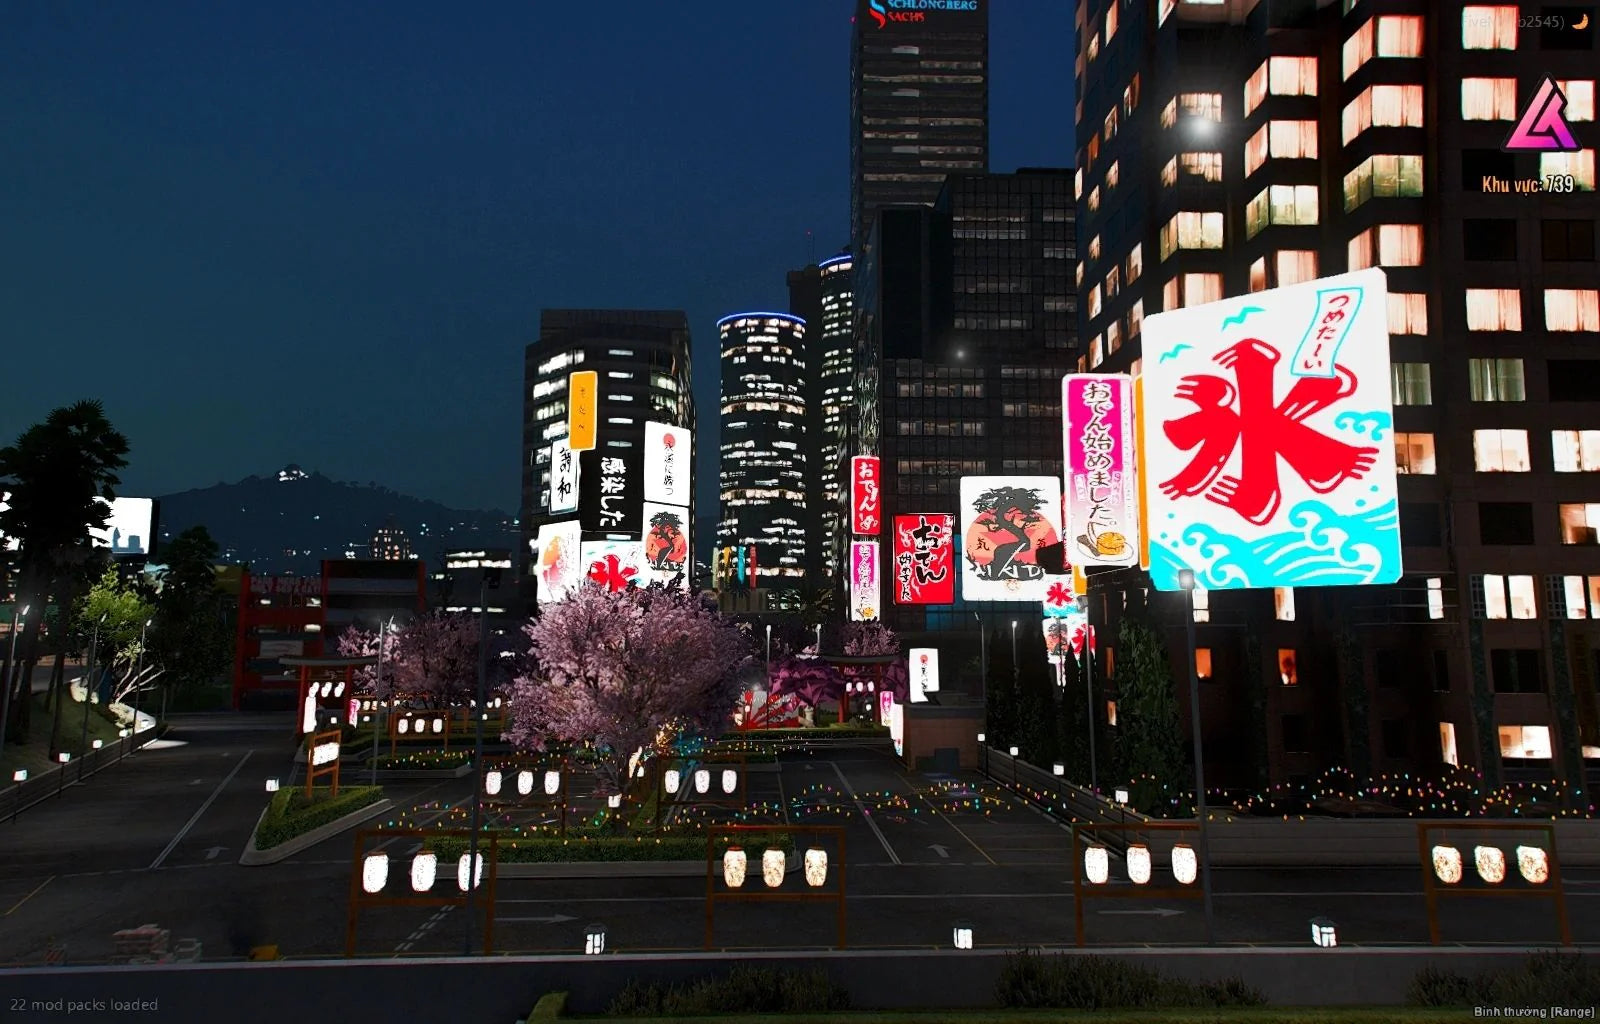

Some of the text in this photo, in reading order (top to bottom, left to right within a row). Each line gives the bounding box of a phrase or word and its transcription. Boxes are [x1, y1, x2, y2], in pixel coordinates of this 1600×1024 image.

[888, 0, 977, 10] SCHLONGBERG
[888, 11, 924, 22] SACHS
[1157, 338, 1380, 526] 氷
[1046, 582, 1073, 607] 氷
